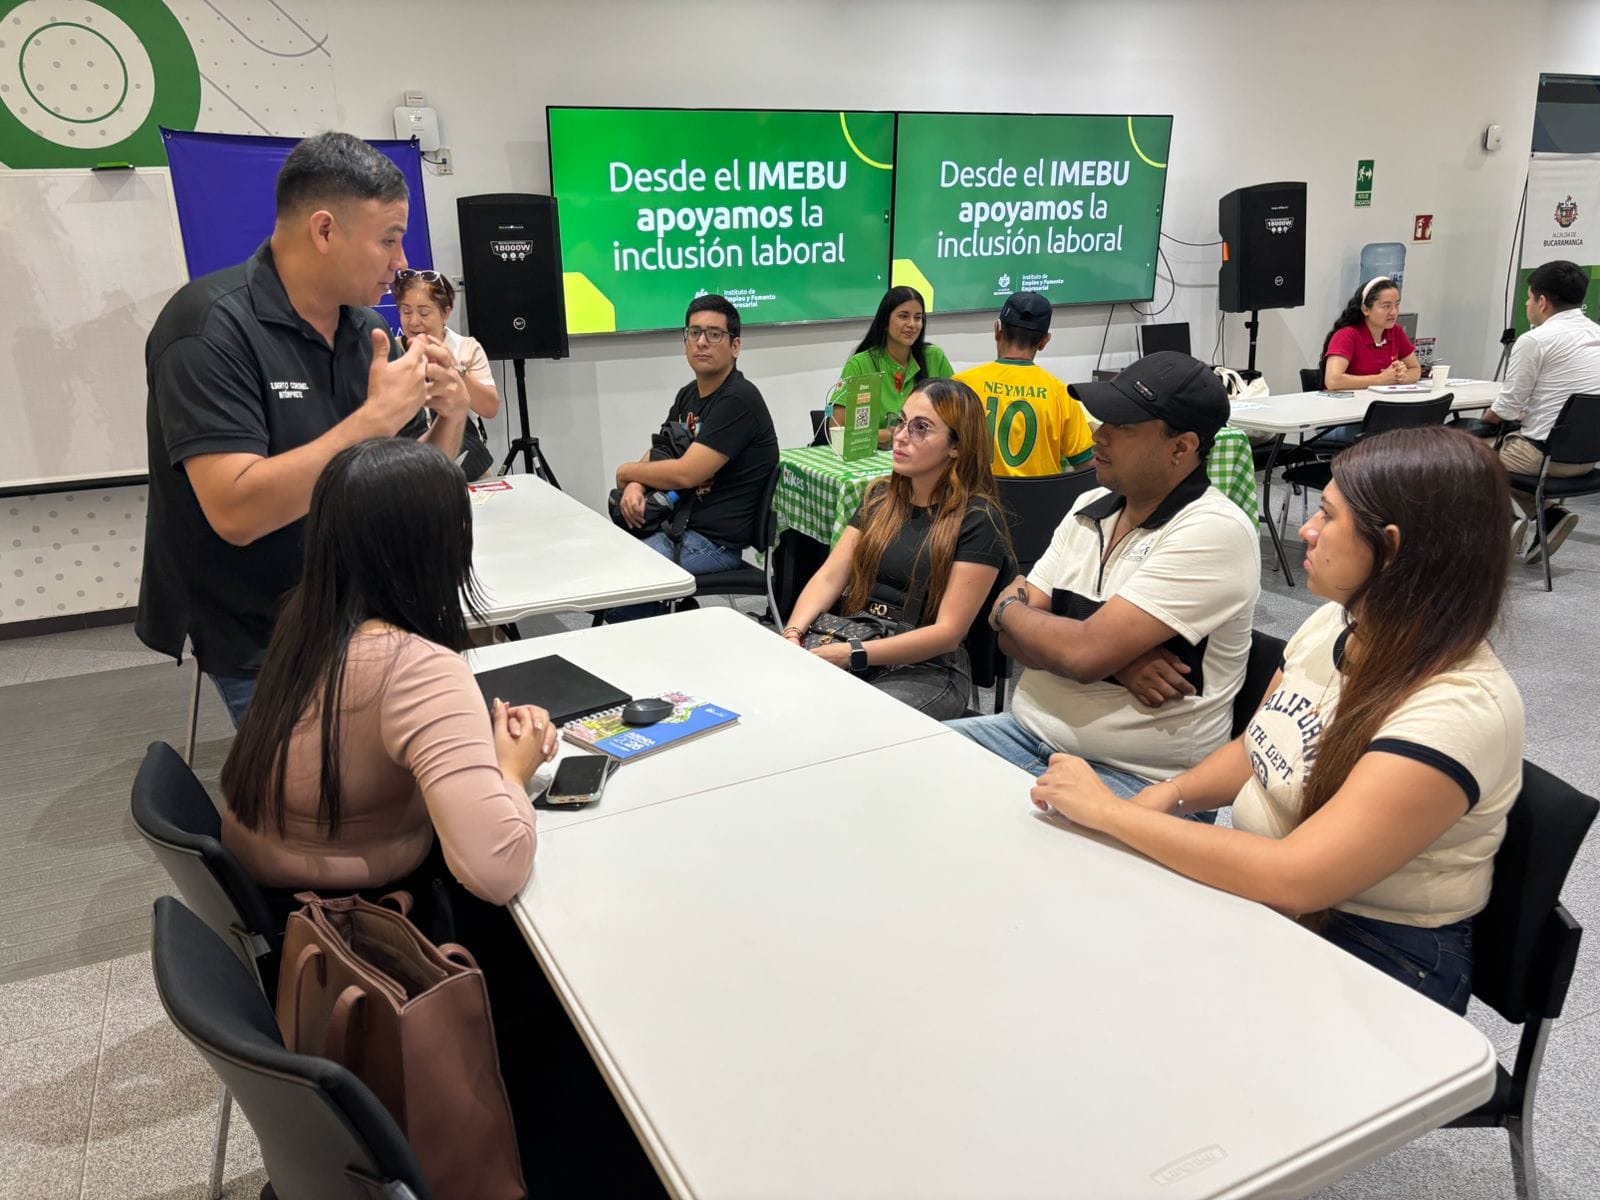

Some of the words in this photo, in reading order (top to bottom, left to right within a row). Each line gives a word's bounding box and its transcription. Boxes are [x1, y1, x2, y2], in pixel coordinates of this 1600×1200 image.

[609, 159, 706, 193] Desde
[714, 158, 741, 191] el
[748, 161, 847, 191] IMEBU
[940, 158, 1017, 188] Desde
[1023, 158, 1044, 187] el
[1050, 160, 1130, 187] IMEBU
[636, 204, 793, 237] apoyamos
[801, 196, 823, 227] la
[958, 199, 1084, 228] apoyamos
[1089, 191, 1108, 220] la
[613, 237, 743, 271] inclusión
[751, 232, 845, 266] laboral
[937, 228, 1041, 258] inclusión
[1047, 224, 1123, 254] laboral
[1543, 239, 1583, 247] BUCARAMANGA
[748, 287, 756, 295] de
[983, 381, 1048, 399] NEYMAR
[985, 396, 1038, 467] 10
